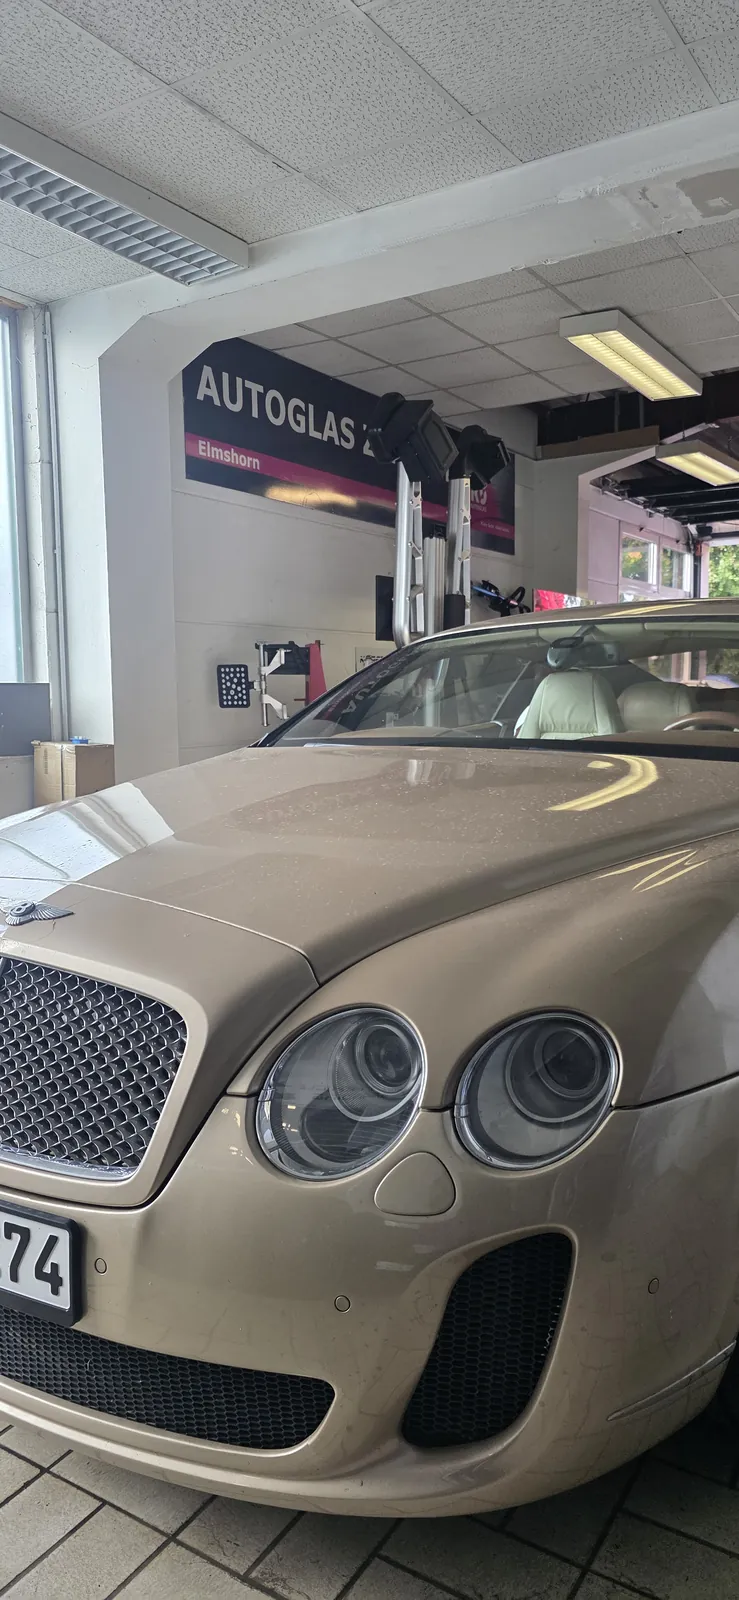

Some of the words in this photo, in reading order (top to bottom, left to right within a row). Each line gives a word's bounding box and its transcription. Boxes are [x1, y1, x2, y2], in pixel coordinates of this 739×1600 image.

[196, 364, 355, 450] AUTOGLAS
[198, 439, 260, 471] Elmshorn
[0, 1221, 63, 1296] 74
